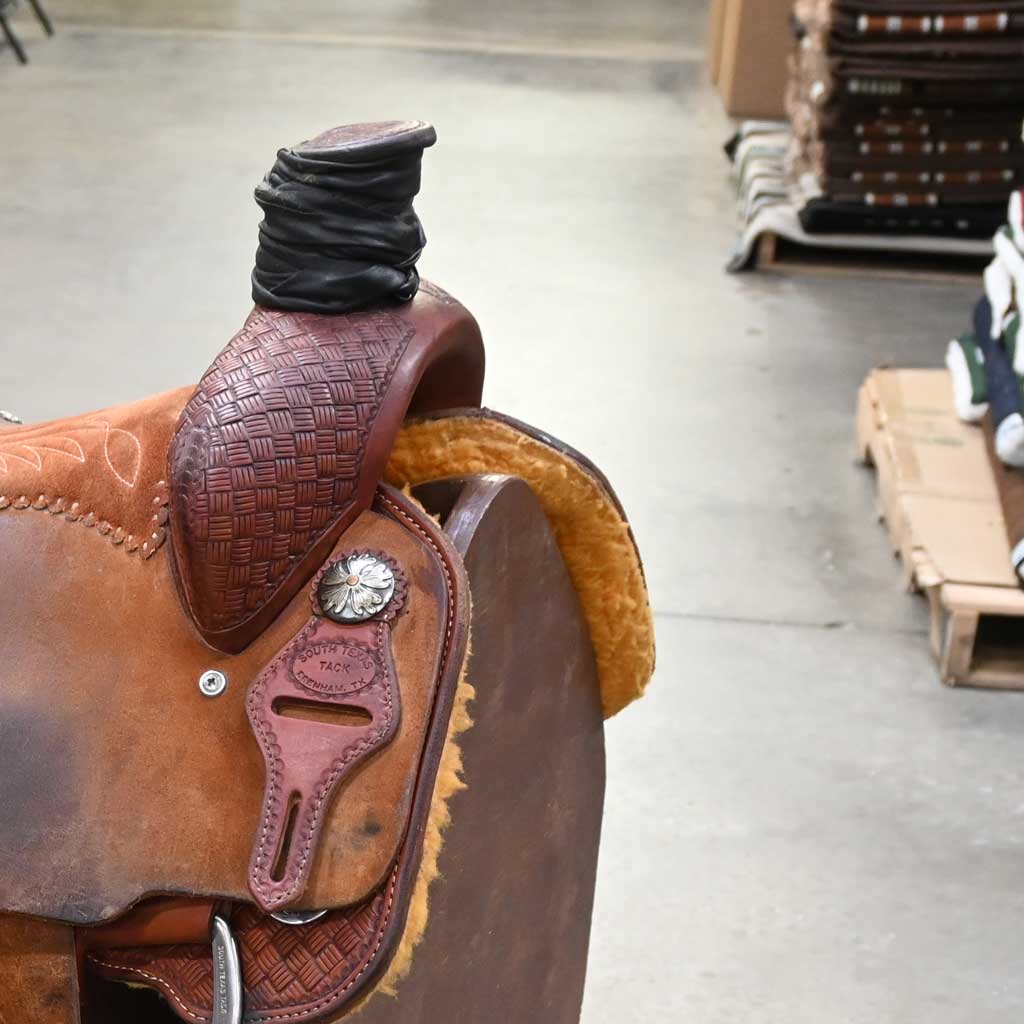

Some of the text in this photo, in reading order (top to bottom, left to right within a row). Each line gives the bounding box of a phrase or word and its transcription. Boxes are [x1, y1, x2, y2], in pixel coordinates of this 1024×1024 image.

[297, 644, 337, 663] SOUTH
[319, 661, 351, 674] TACK
[350, 677, 367, 690] TX
